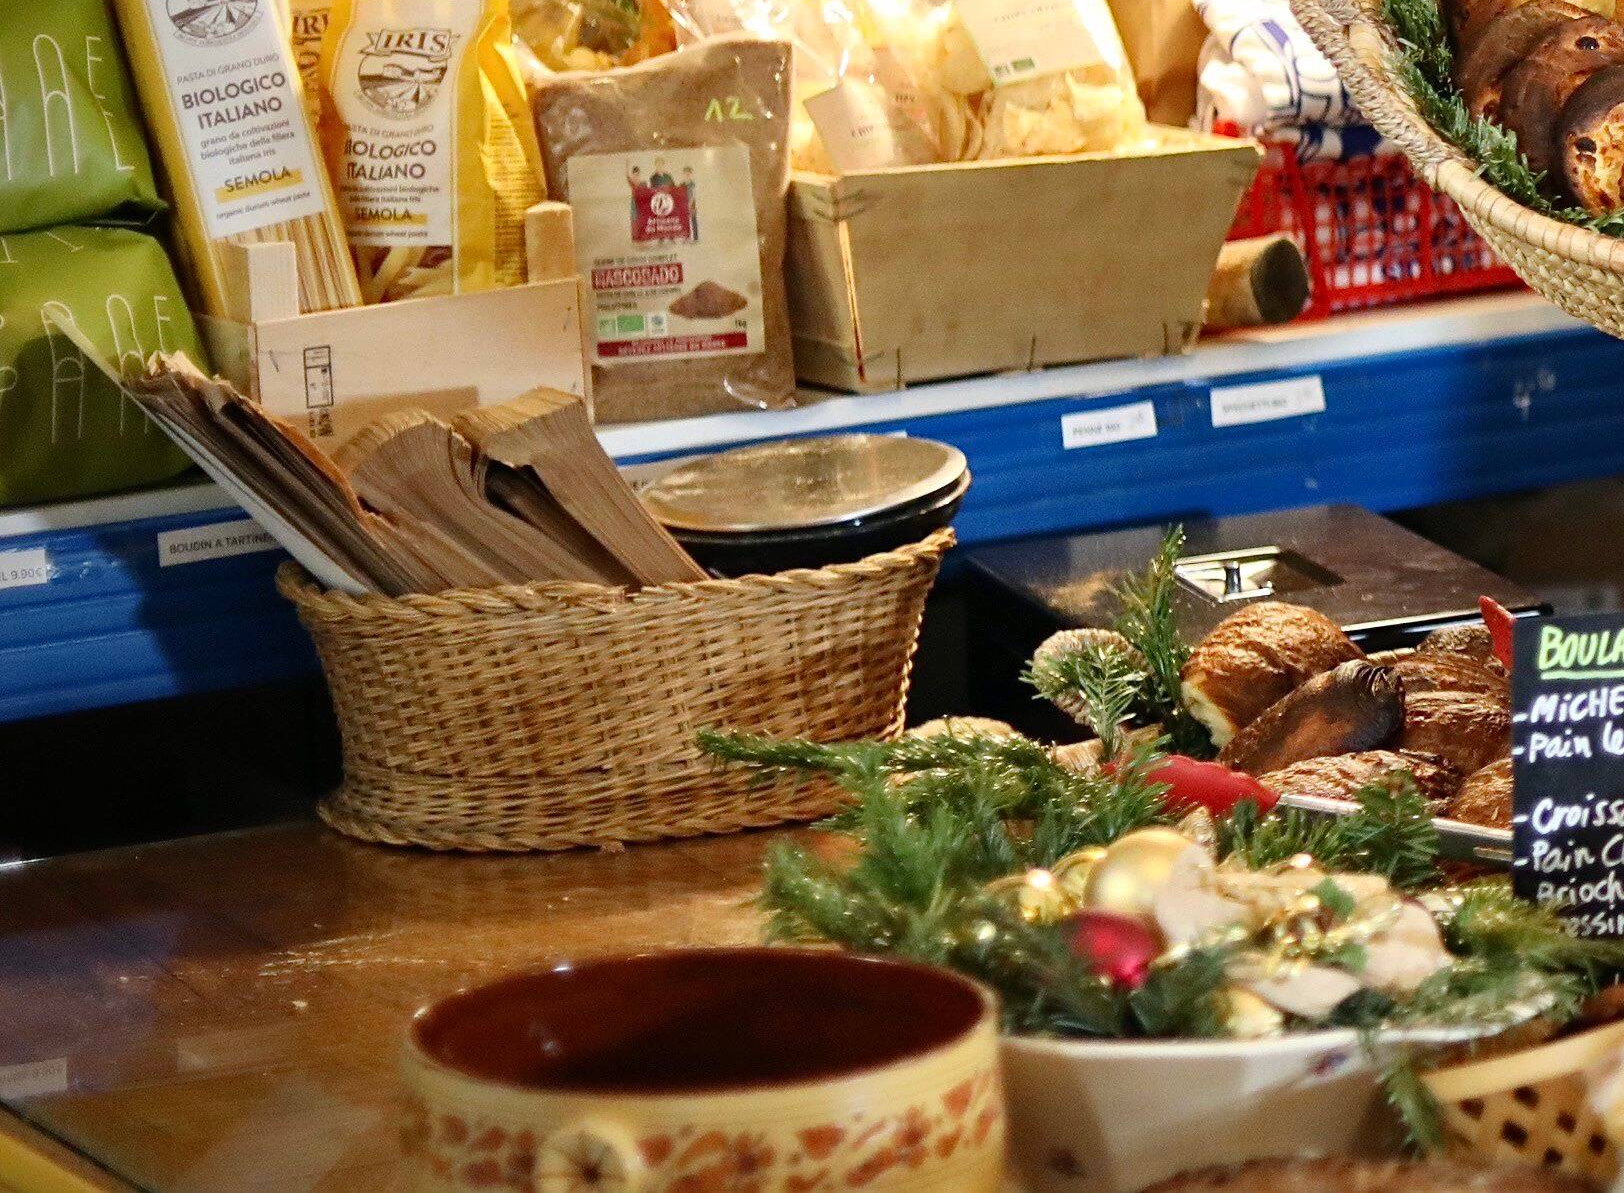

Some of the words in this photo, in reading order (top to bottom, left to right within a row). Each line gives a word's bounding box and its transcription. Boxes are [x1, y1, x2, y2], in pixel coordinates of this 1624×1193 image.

[382, 32, 449, 51] IRIS
[181, 71, 286, 110] BIOLOGICO
[198, 96, 283, 130] ITALIANO
[224, 165, 291, 193] SEMOLA
[169, 539, 213, 555] BOUDIN
